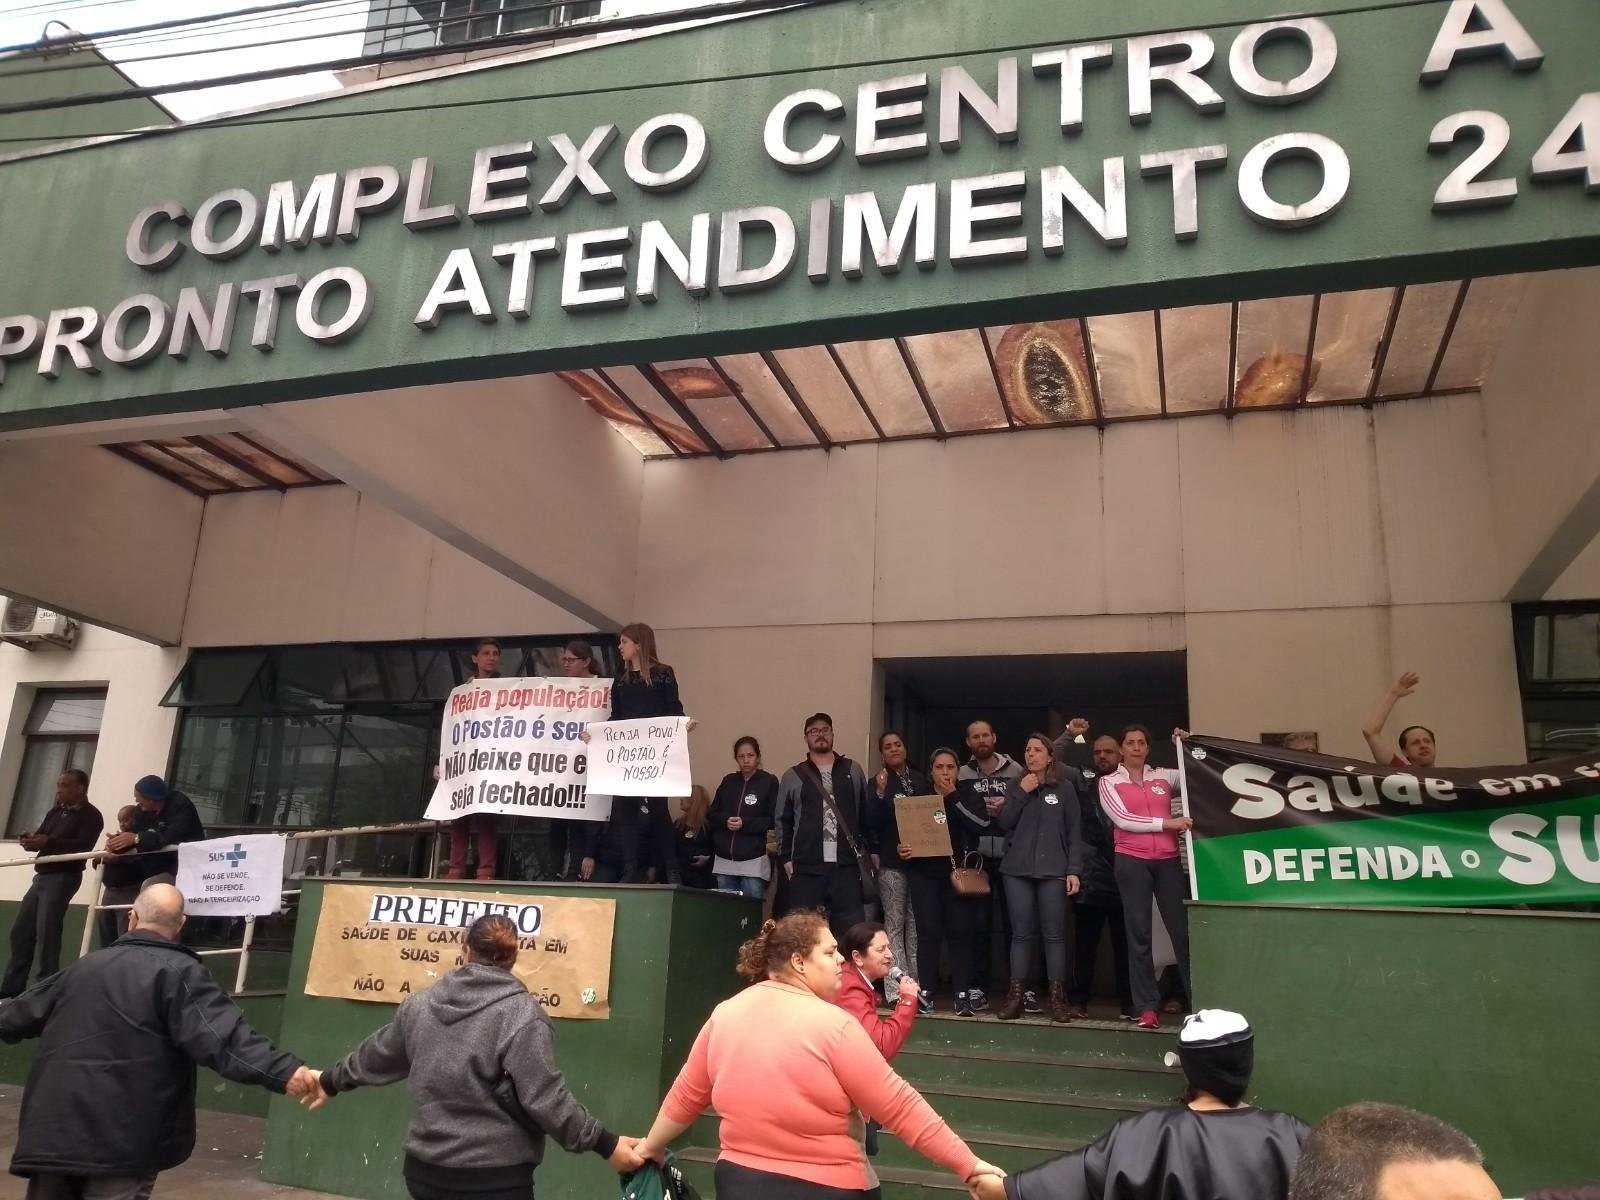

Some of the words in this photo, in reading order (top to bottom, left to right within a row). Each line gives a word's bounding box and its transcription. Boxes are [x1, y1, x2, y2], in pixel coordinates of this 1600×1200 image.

[127, 112, 711, 271] COMPLEXO
[764, 17, 1338, 172] CENTRO
[1419, 0, 1545, 88] A
[0, 266, 374, 386] PRONTO
[414, 131, 1352, 330] ATENDIMENTO
[1427, 91, 1600, 213] 24
[450, 687, 492, 716] Reaja
[495, 685, 609, 712] população!
[463, 715, 527, 743] Postão
[532, 714, 545, 739] é
[604, 726, 640, 742] REAJA
[445, 750, 466, 781] NÃO
[468, 747, 522, 773] deixe
[527, 752, 568, 776] que
[618, 745, 656, 764] POSTÃO
[450, 783, 474, 811] seja
[478, 779, 587, 809] fechado!!!
[1222, 763, 1458, 819] Saúde
[1479, 773, 1561, 796] em
[208, 852, 225, 862] SUS
[1243, 846, 1453, 885] DEFENDA
[205, 884, 214, 892] SE
[217, 872, 225, 880] SE
[396, 927, 418, 941] DE
[545, 938, 568, 955] EM
[400, 948, 440, 963] SUAS
[353, 972, 385, 992] NÃO
[399, 980, 411, 994] A
